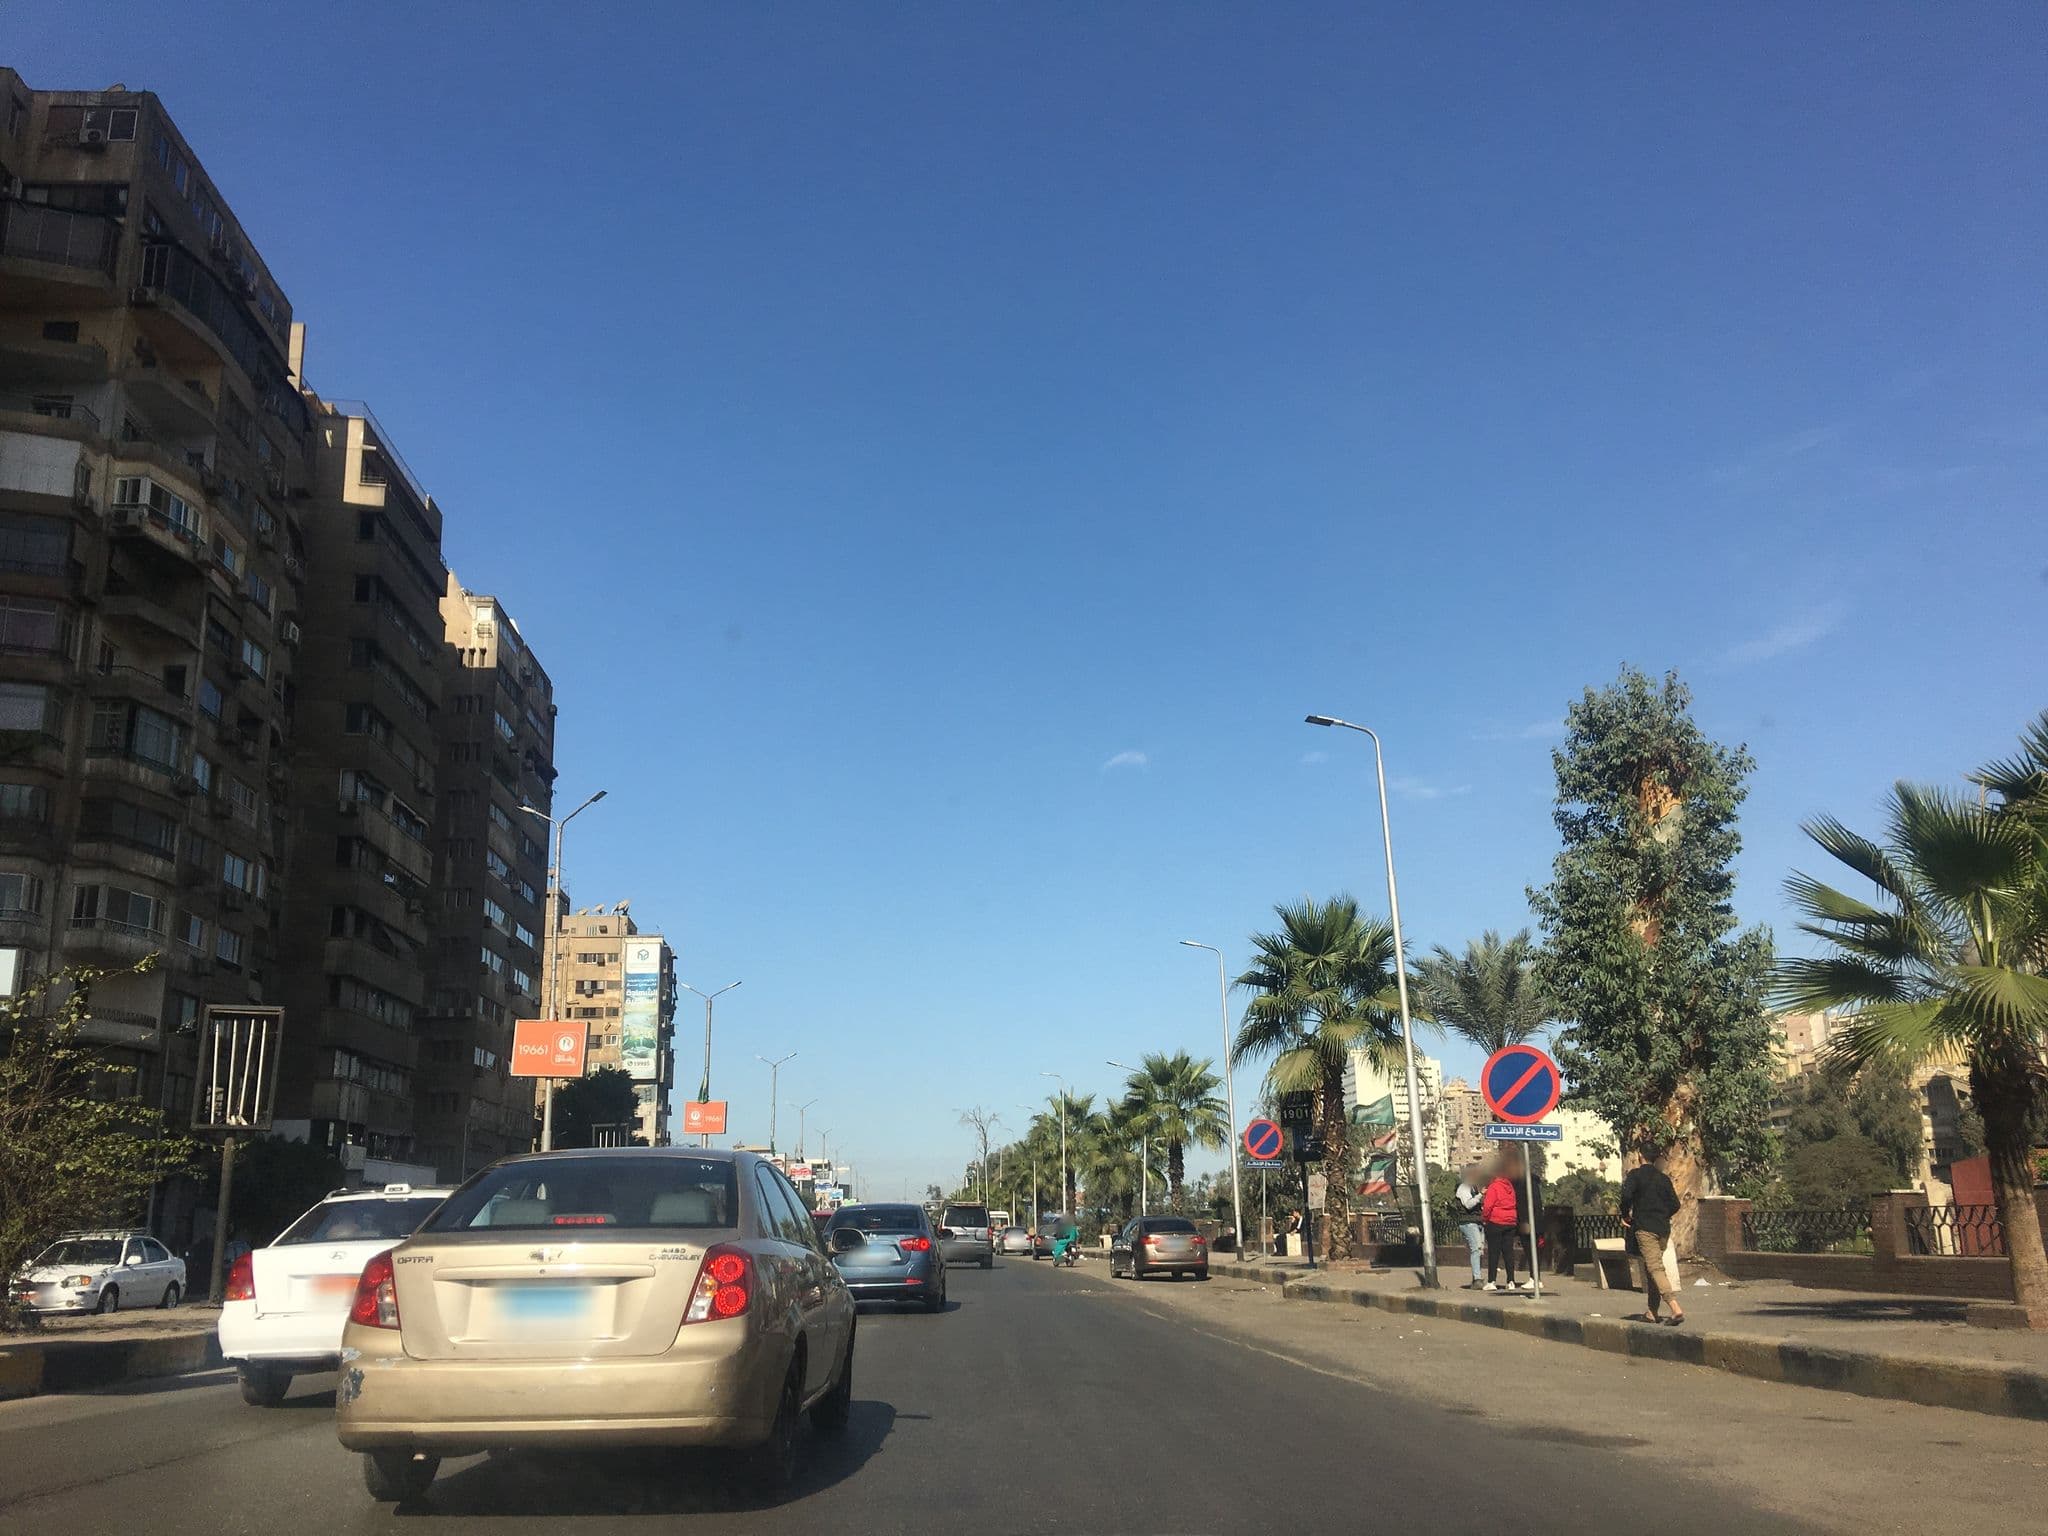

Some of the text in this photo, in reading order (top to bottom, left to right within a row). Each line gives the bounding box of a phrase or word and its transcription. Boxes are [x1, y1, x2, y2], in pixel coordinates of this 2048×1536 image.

[519, 1044, 549, 1055] 19661
[1525, 1127, 1558, 1136] ممنوع
[397, 1256, 434, 1264] OPTRA
